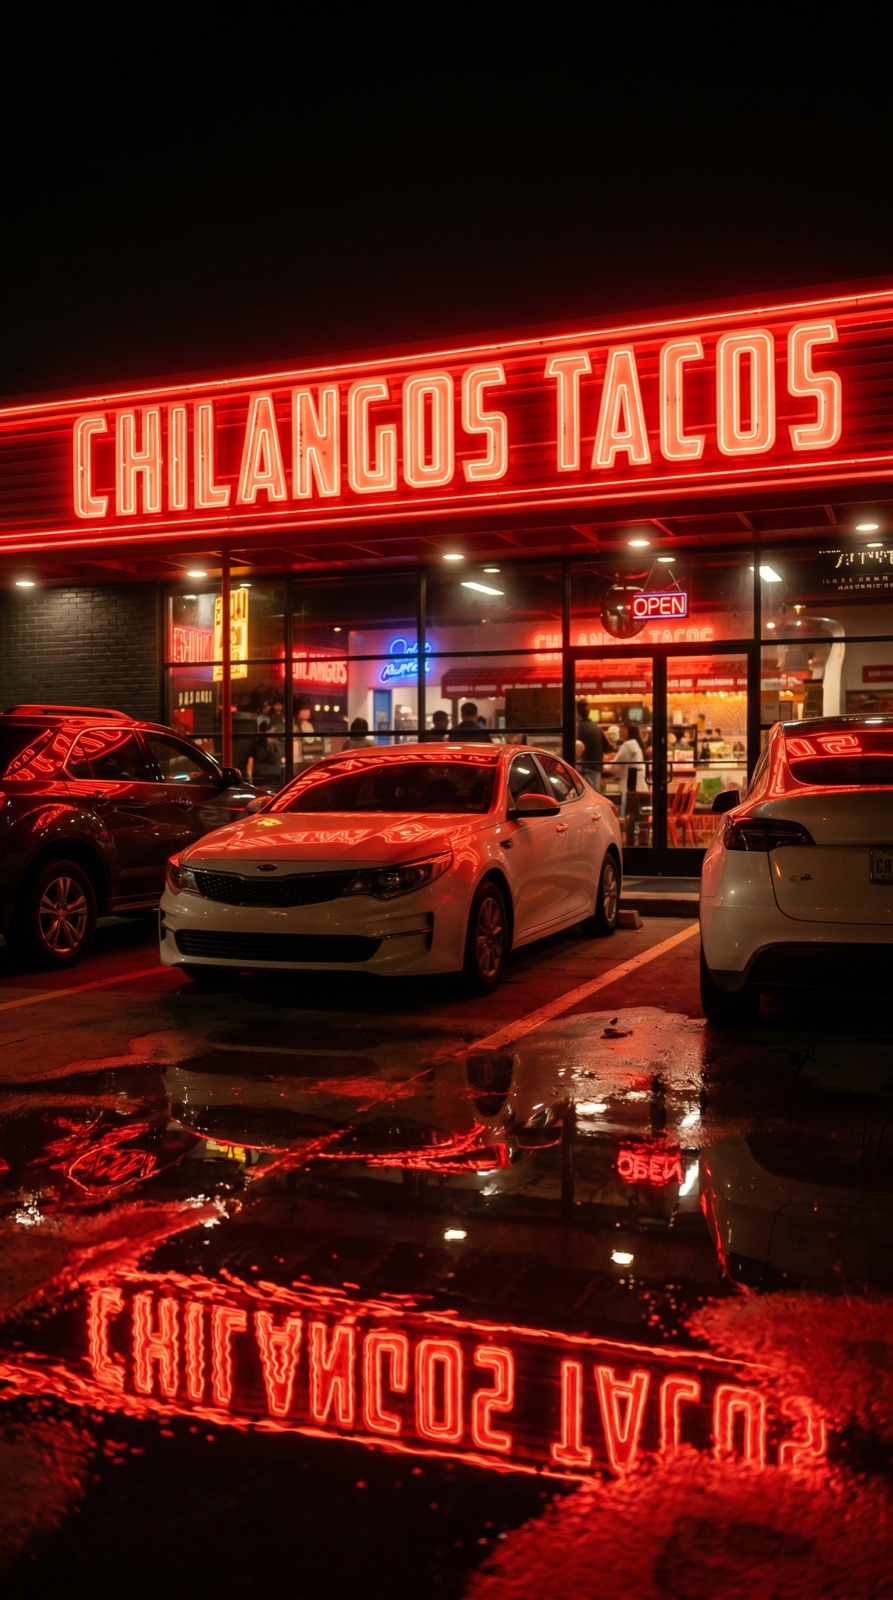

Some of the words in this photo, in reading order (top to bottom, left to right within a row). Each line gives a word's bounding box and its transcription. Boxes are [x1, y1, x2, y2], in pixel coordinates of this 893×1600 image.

[73, 363, 509, 519] CHILANGOS
[544, 319, 843, 473] TACOS
[633, 595, 685, 617] OPEN
